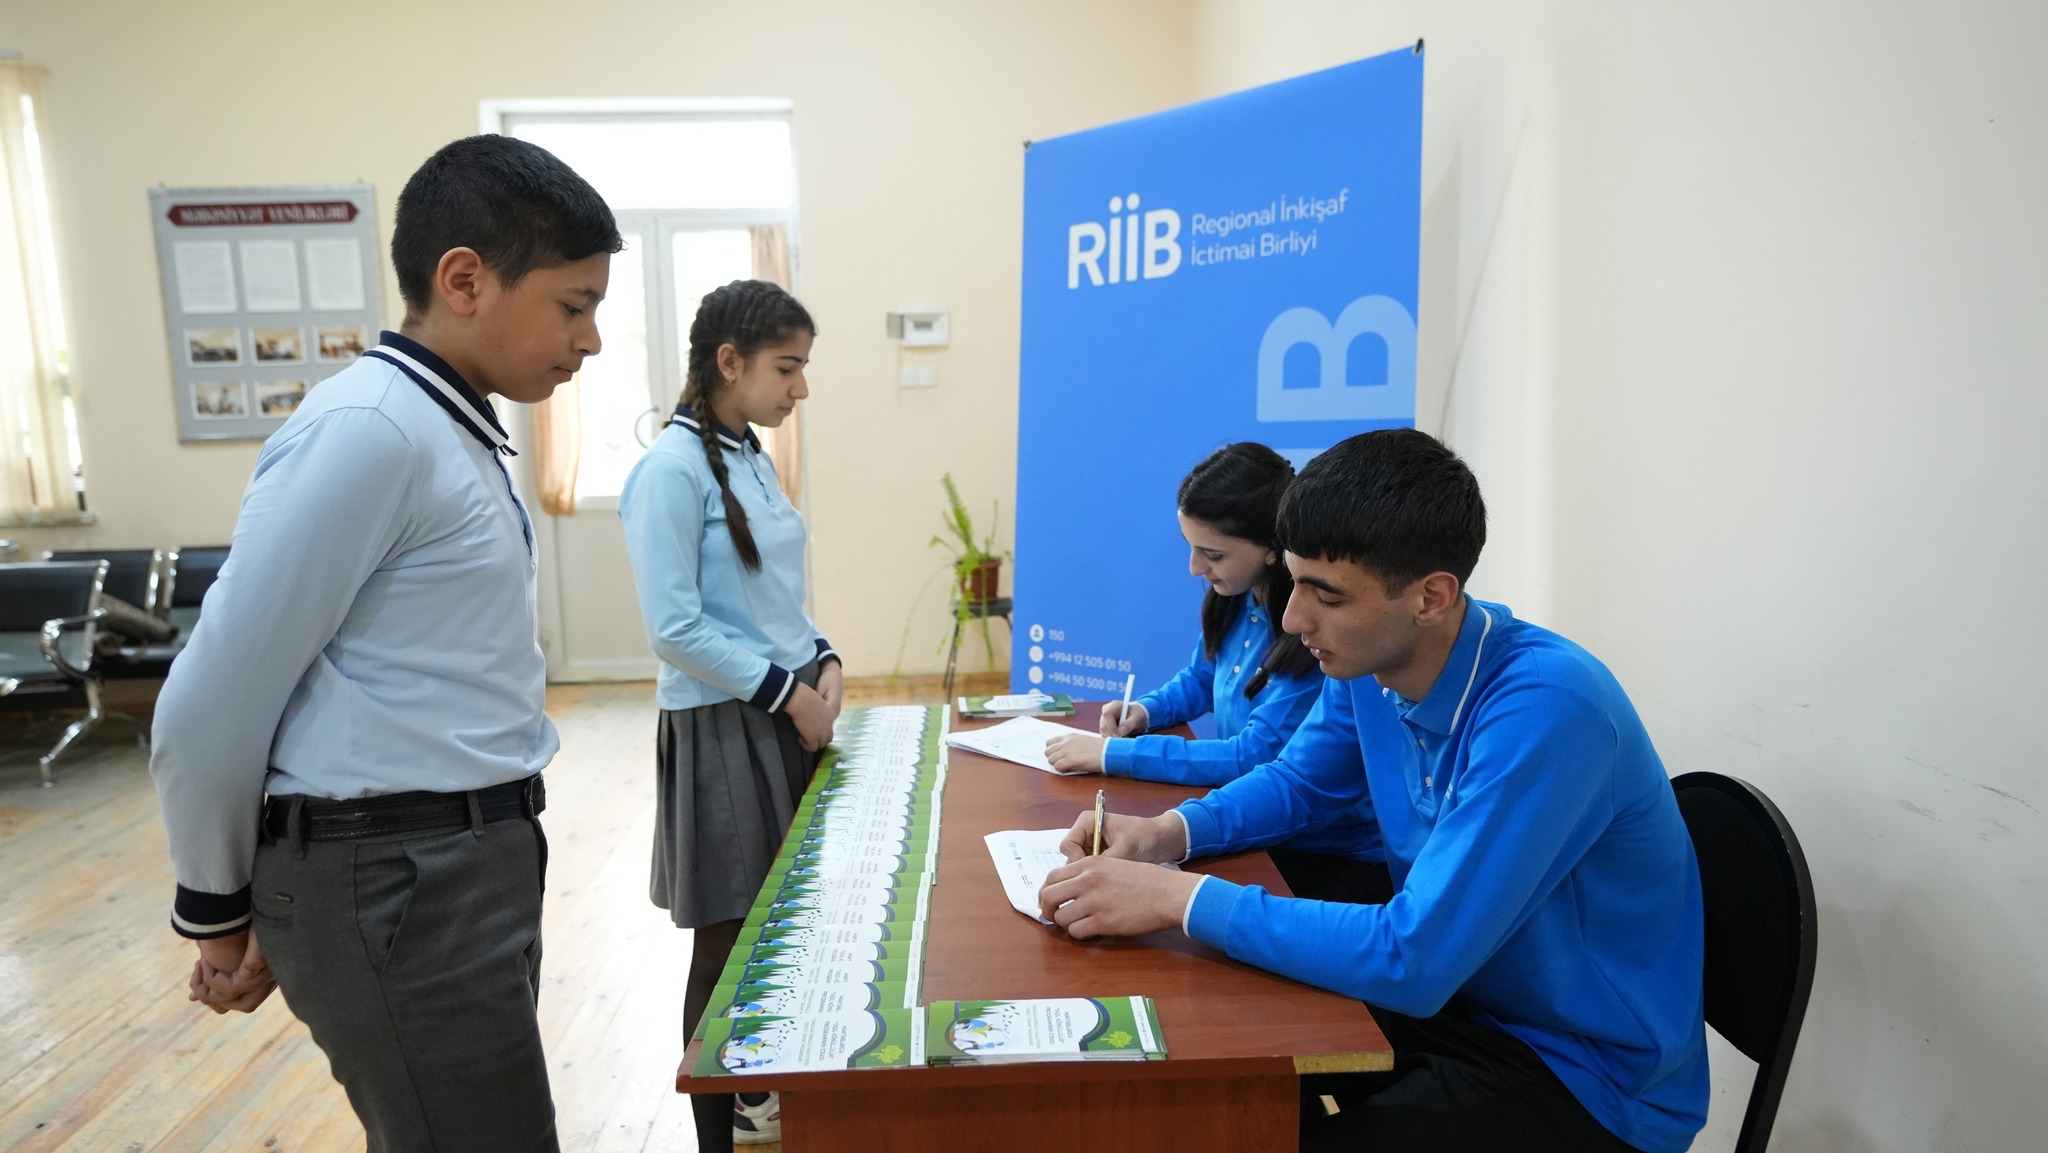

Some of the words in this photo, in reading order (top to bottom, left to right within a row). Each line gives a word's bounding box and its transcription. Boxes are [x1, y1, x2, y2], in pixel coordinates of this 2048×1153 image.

[1191, 201, 1276, 237] Regional
[1280, 188, 1349, 222] İnkişaf
[1191, 237, 1256, 266] İctimai
[1260, 229, 1317, 257] Birliyi
[1049, 629, 1065, 641] 150
[1049, 651, 1072, 664] +994
[1073, 654, 1084, 666] 12
[1085, 656, 1104, 668] 505
[1105, 659, 1117, 670] 01
[1118, 660, 1132, 672] 50
[1049, 672, 1071, 684] +994
[1072, 674, 1085, 687] 50
[1086, 676, 1105, 690] 500
[1106, 679, 1117, 691] 01
